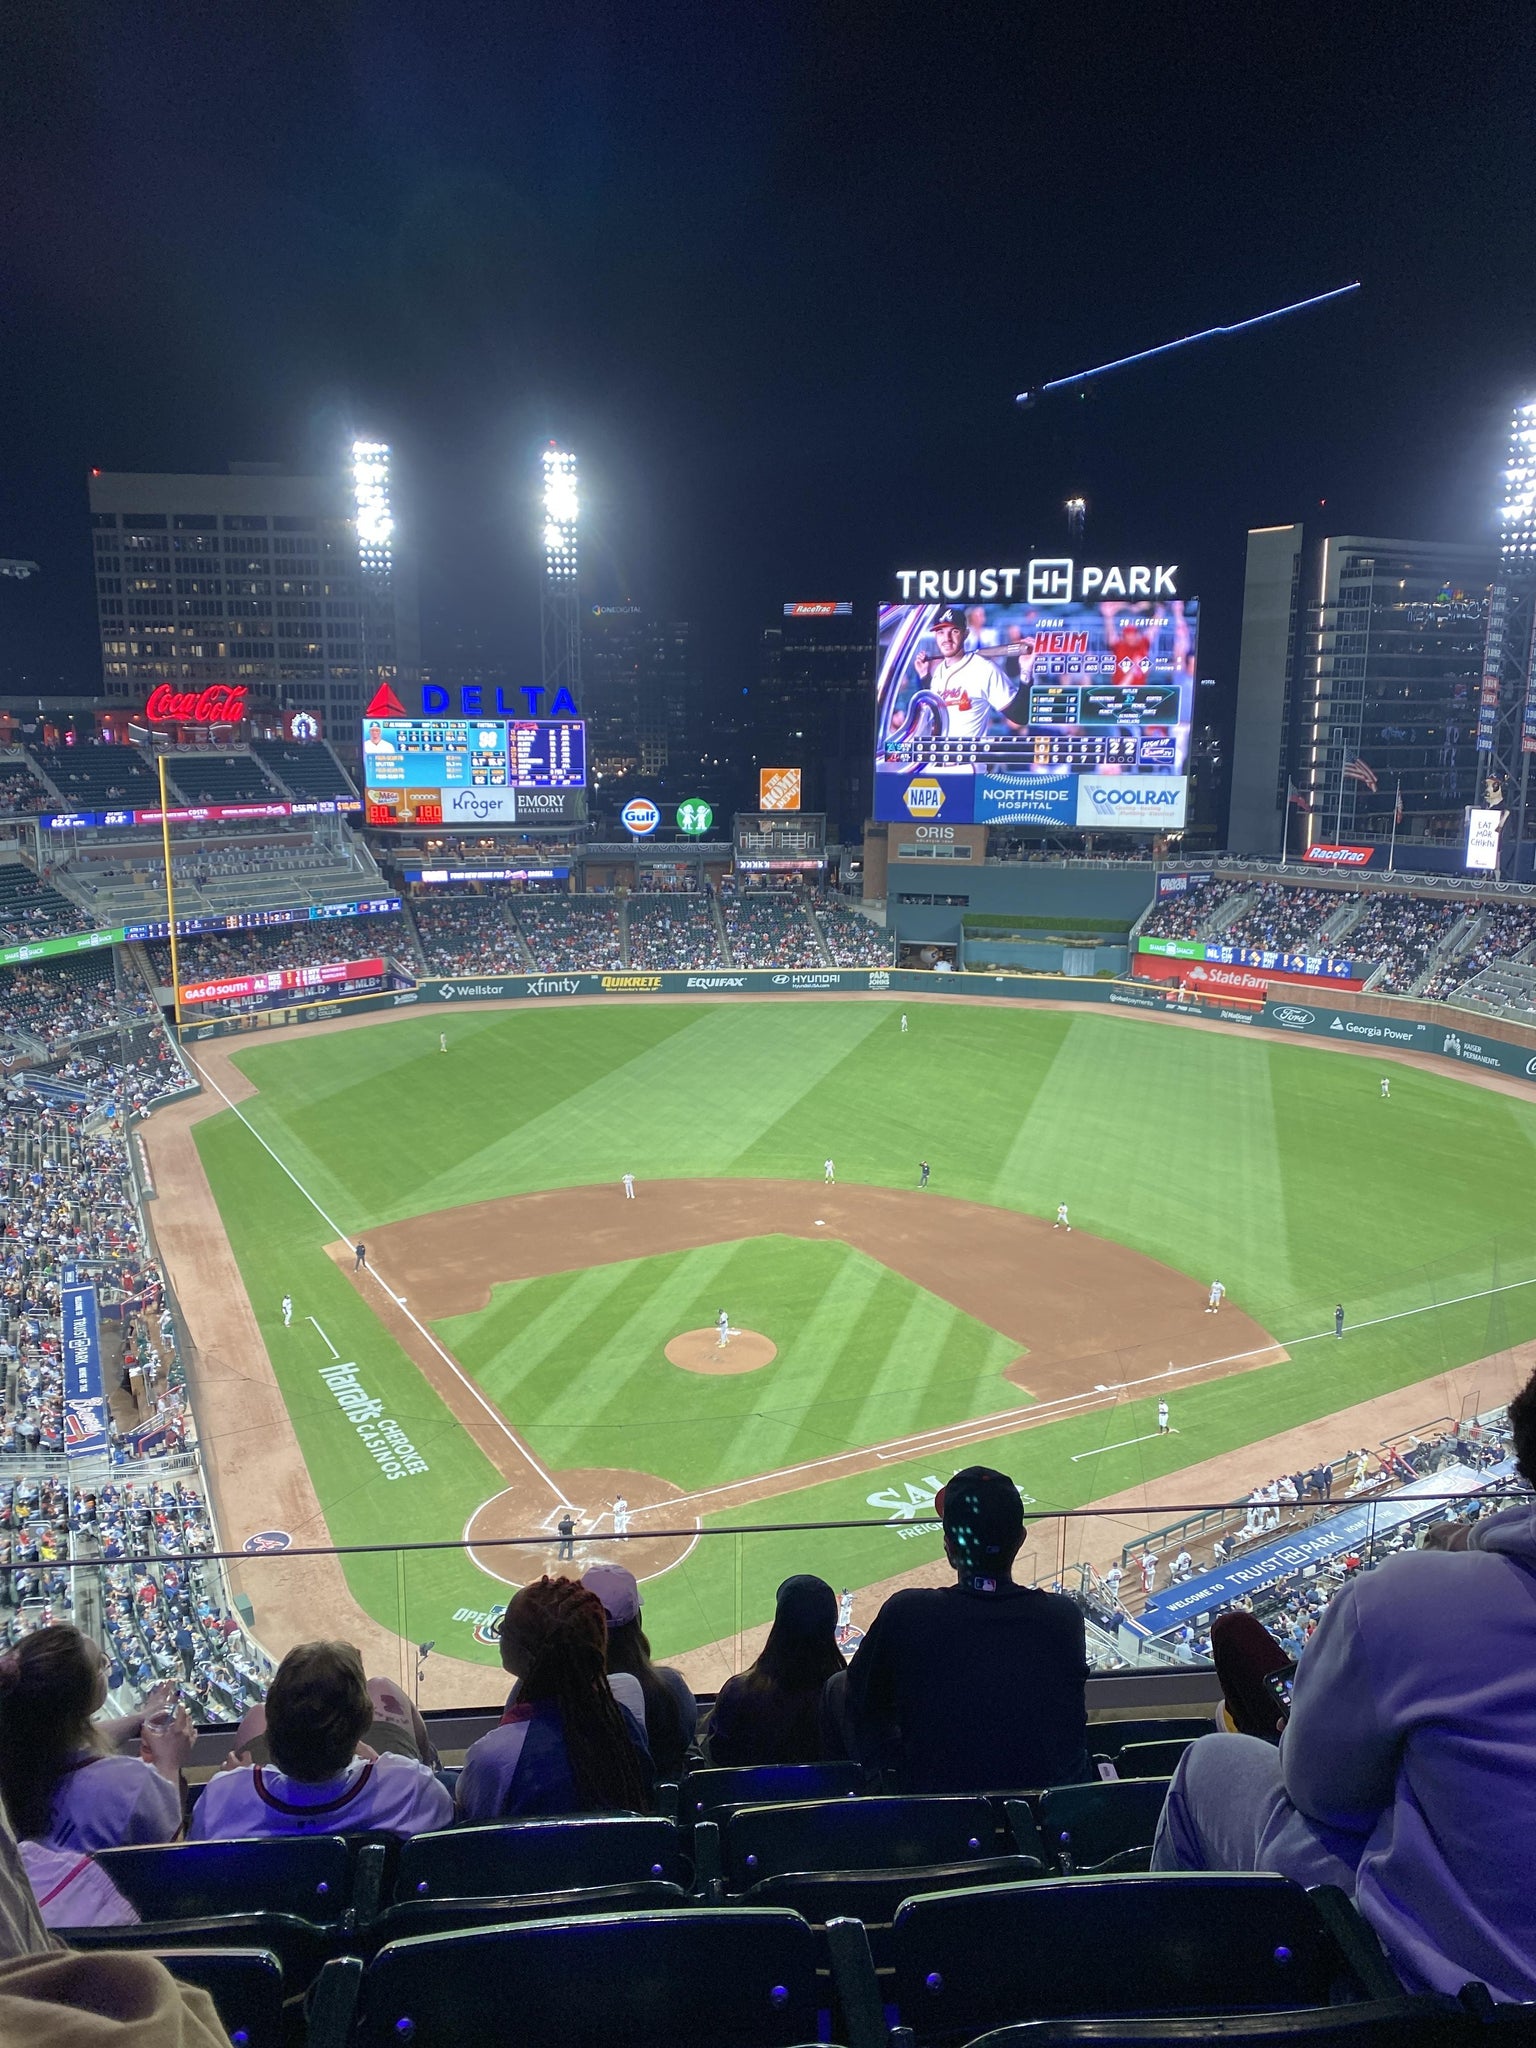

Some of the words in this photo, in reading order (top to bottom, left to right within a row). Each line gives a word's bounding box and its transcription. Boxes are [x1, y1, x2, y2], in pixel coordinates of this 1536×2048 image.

[896, 568, 1020, 599] TRUIST
[1083, 565, 1179, 596] PARK
[796, 604, 831, 614] RaceTrac
[1036, 619, 1064, 628] JONAH
[1135, 619, 1169, 627] CATCHER
[1034, 631, 1088, 654] HEIM
[147, 683, 248, 723] Coca-Cola
[421, 684, 578, 716] DELTA
[1483, 694, 1495, 703] 1957
[1110, 743, 1119, 754] 2
[1124, 743, 1135, 754] 2
[1479, 740, 1492, 749] 1993
[764, 773, 782, 789] THE
[762, 769, 800, 808] HOME
[983, 789, 1069, 801] NORTHSIDE
[518, 795, 565, 807] EMORY
[776, 784, 800, 809] DEPOT
[910, 790, 939, 806] NAPA
[1093, 789, 1181, 805] COOLRAY
[370, 805, 389, 818] 80
[420, 805, 442, 818] 180
[453, 791, 503, 819] Kroger
[998, 801, 1053, 810] HOSPITAL
[624, 811, 657, 822] Gulf
[1478, 821, 1492, 829] EAT
[916, 826, 955, 839] ORIS
[1476, 830, 1492, 838] MOR
[1308, 847, 1366, 862] RaceTrac
[210, 861, 261, 875] AARON
[269, 857, 334, 871] TERRACE
[1149, 944, 1166, 952] SHAKE
[1176, 947, 1195, 955] SHACK
[355, 978, 380, 989] MLB+
[601, 976, 662, 988] QUIKRETE
[687, 977, 745, 990] EQUIFAX
[792, 974, 840, 983] HYUNDAI
[868, 978, 890, 986] JOHNS
[185, 988, 205, 999] GAS
[216, 983, 248, 995] SOUTH
[254, 978, 267, 990] AL
[304, 985, 331, 996] MLB+
[457, 984, 504, 996] Wellstar
[526, 977, 581, 996] xfinity
[241, 994, 269, 1006] MLB+
[1228, 1012, 1253, 1022] National
[1279, 1008, 1308, 1023] Ford
[1346, 1022, 1382, 1039] Georgia
[1384, 1028, 1413, 1041] Power
[1463, 1042, 1482, 1053] KAISER
[1463, 1051, 1499, 1067] PERMANENTE
[75, 1347, 89, 1365] PARK
[356, 1424, 408, 1481] CASINOS
[377, 1419, 430, 1476] CHEROKEE
[1166, 1587, 1209, 1612] WELCOME
[1209, 1583, 1225, 1595] TO
[1225, 1556, 1284, 1586] TRUIST
[1298, 1531, 1345, 1554] PARK
